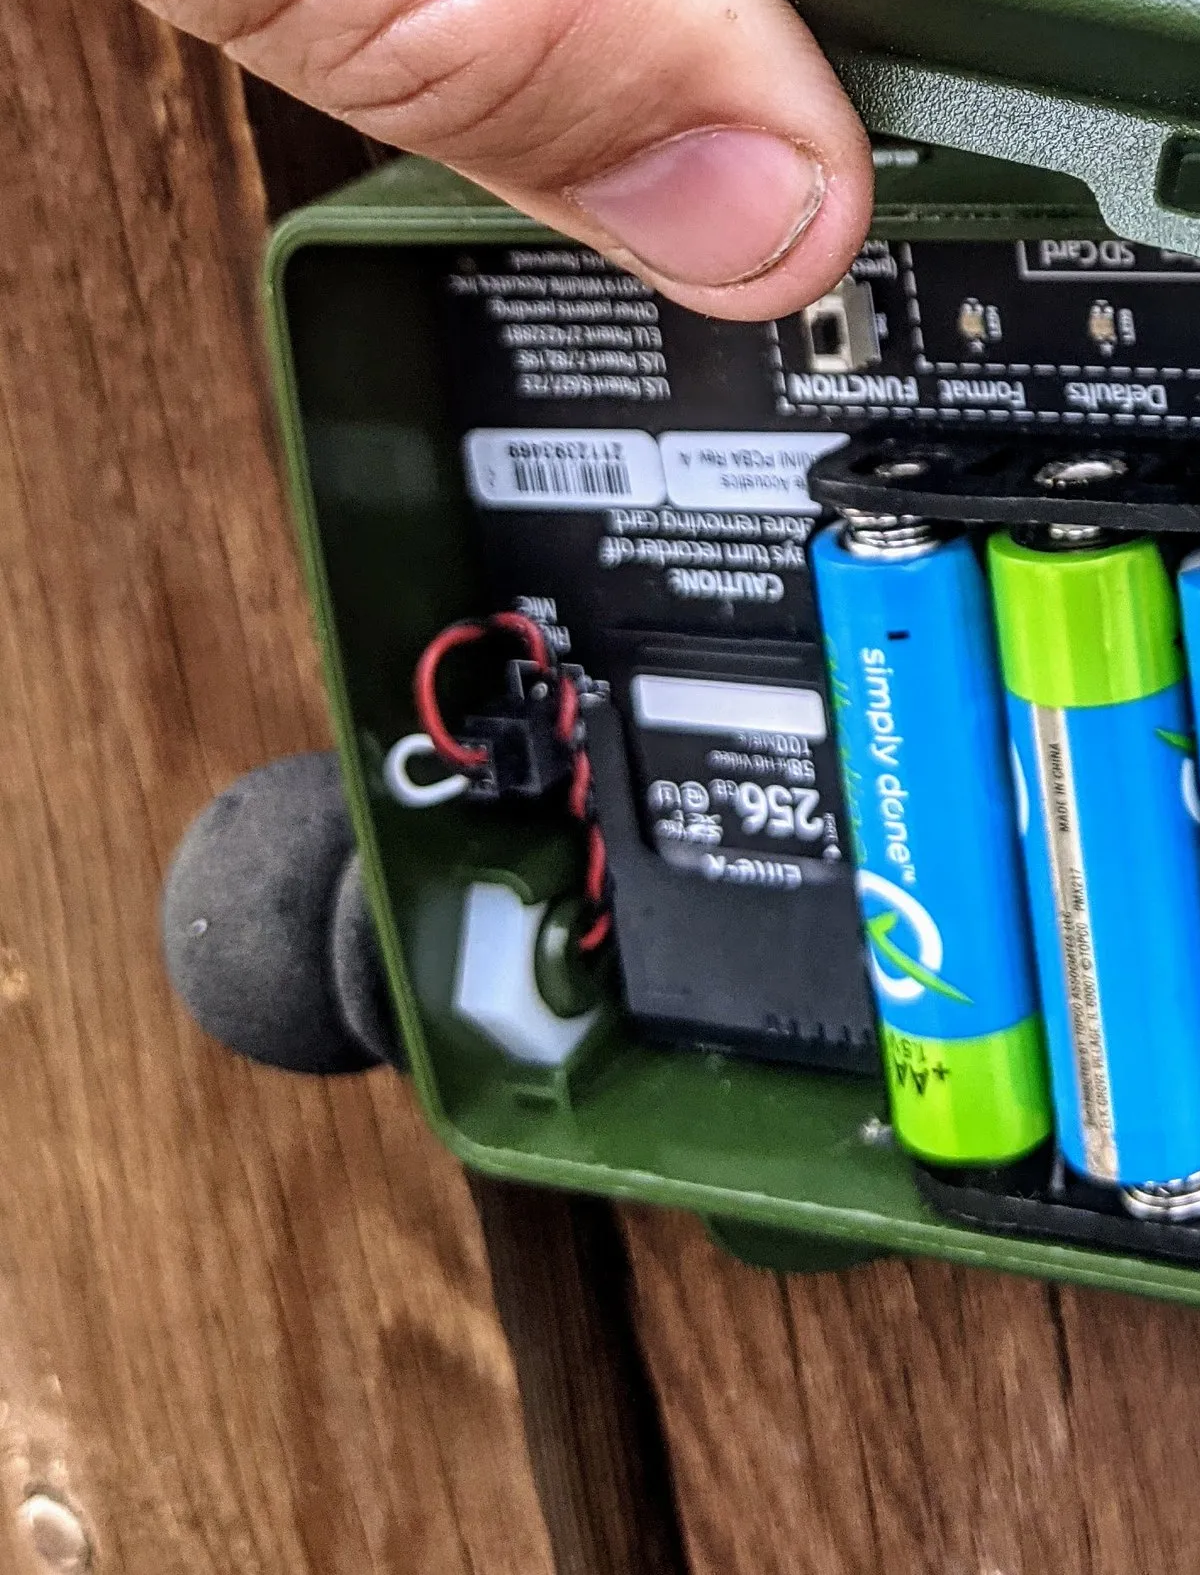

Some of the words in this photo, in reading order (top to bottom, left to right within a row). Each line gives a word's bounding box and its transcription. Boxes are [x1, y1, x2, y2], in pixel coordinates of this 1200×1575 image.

[1039, 239, 1097, 267] Card
[1100, 240, 1137, 267] SD
[787, 372, 920, 405] FUNCTION
[937, 378, 1027, 411] Format
[1063, 381, 1169, 414] Defaults
[679, 449, 693, 467] A
[719, 472, 792, 495] Acoustics
[661, 506, 761, 542] removing
[761, 515, 818, 544] efore
[599, 535, 636, 567] off
[634, 537, 724, 568] recorder
[722, 541, 772, 569] turn
[860, 646, 904, 767] simply
[1049, 743, 1064, 780] CHINA
[1053, 782, 1067, 797] IN
[1056, 801, 1072, 833] MADE
[1068, 866, 1087, 913] PMX217
